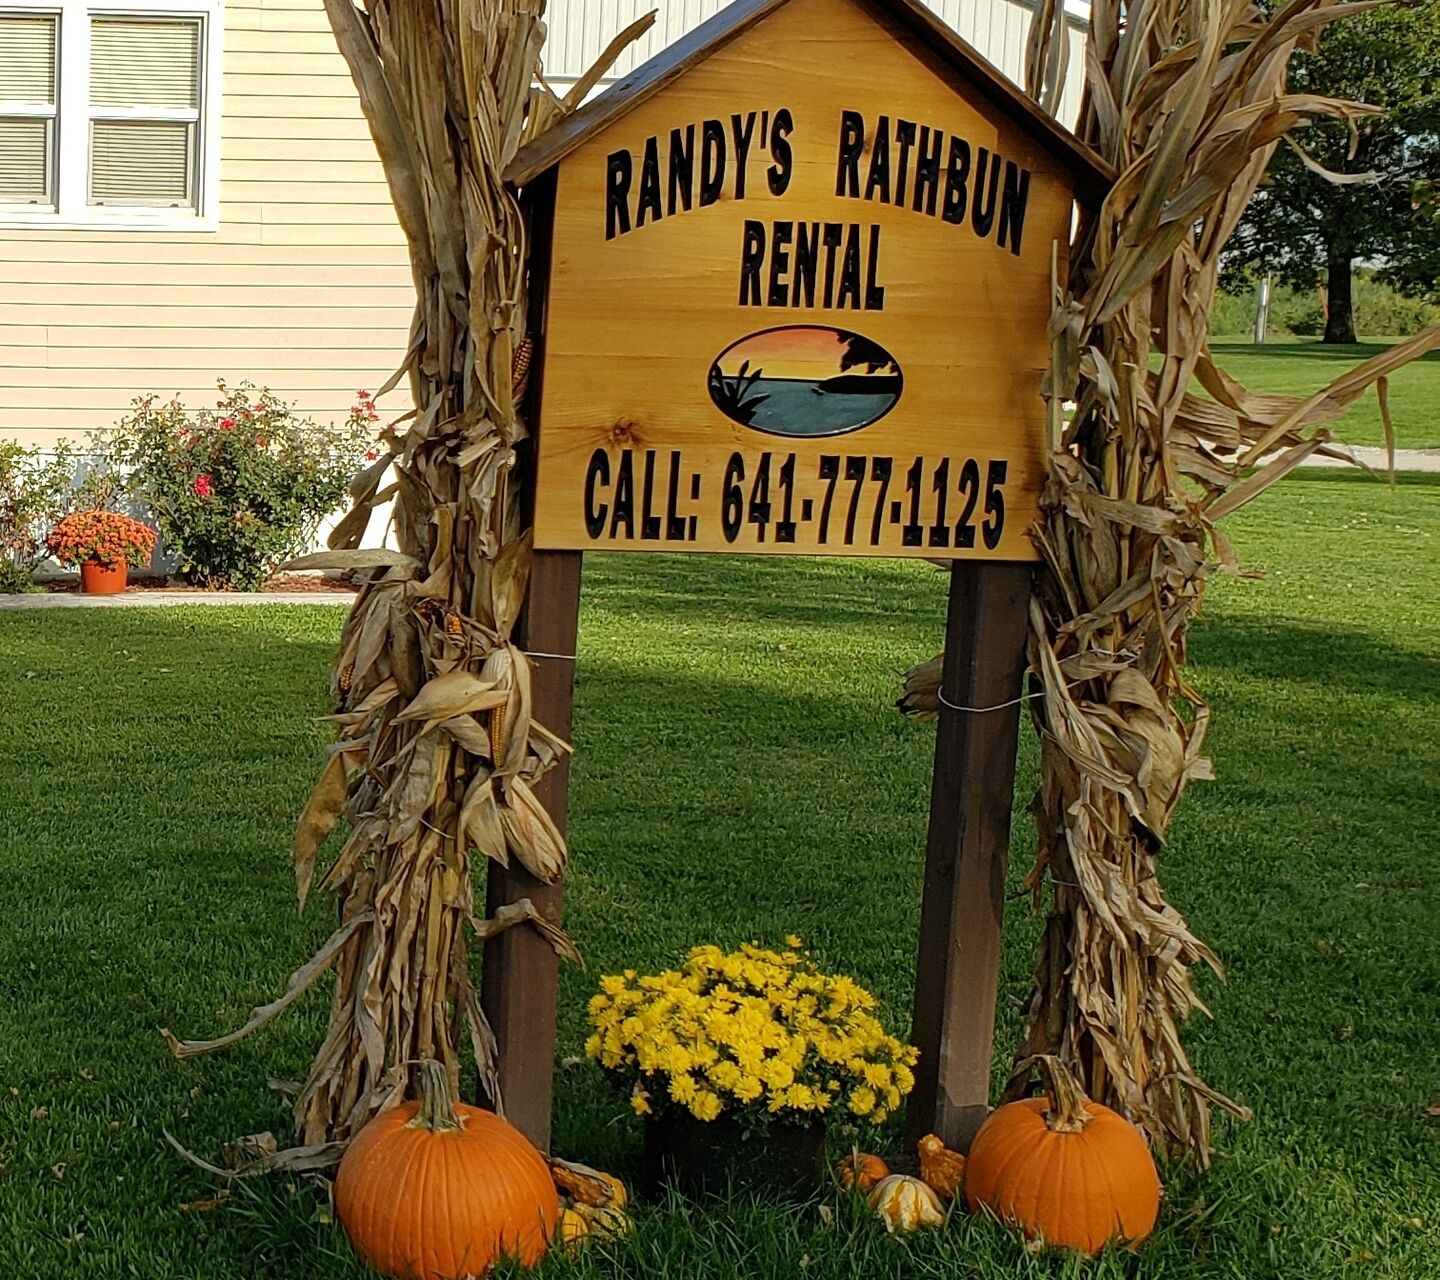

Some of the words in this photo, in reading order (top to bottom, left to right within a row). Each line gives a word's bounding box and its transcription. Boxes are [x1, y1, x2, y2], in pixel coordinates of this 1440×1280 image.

[605, 108, 794, 241] RANDY'S
[835, 110, 1031, 257] RATHBUN
[738, 219, 885, 311] RENTAL
[584, 448, 701, 541] CALL:
[721, 451, 1008, 550] 641-777-1125
